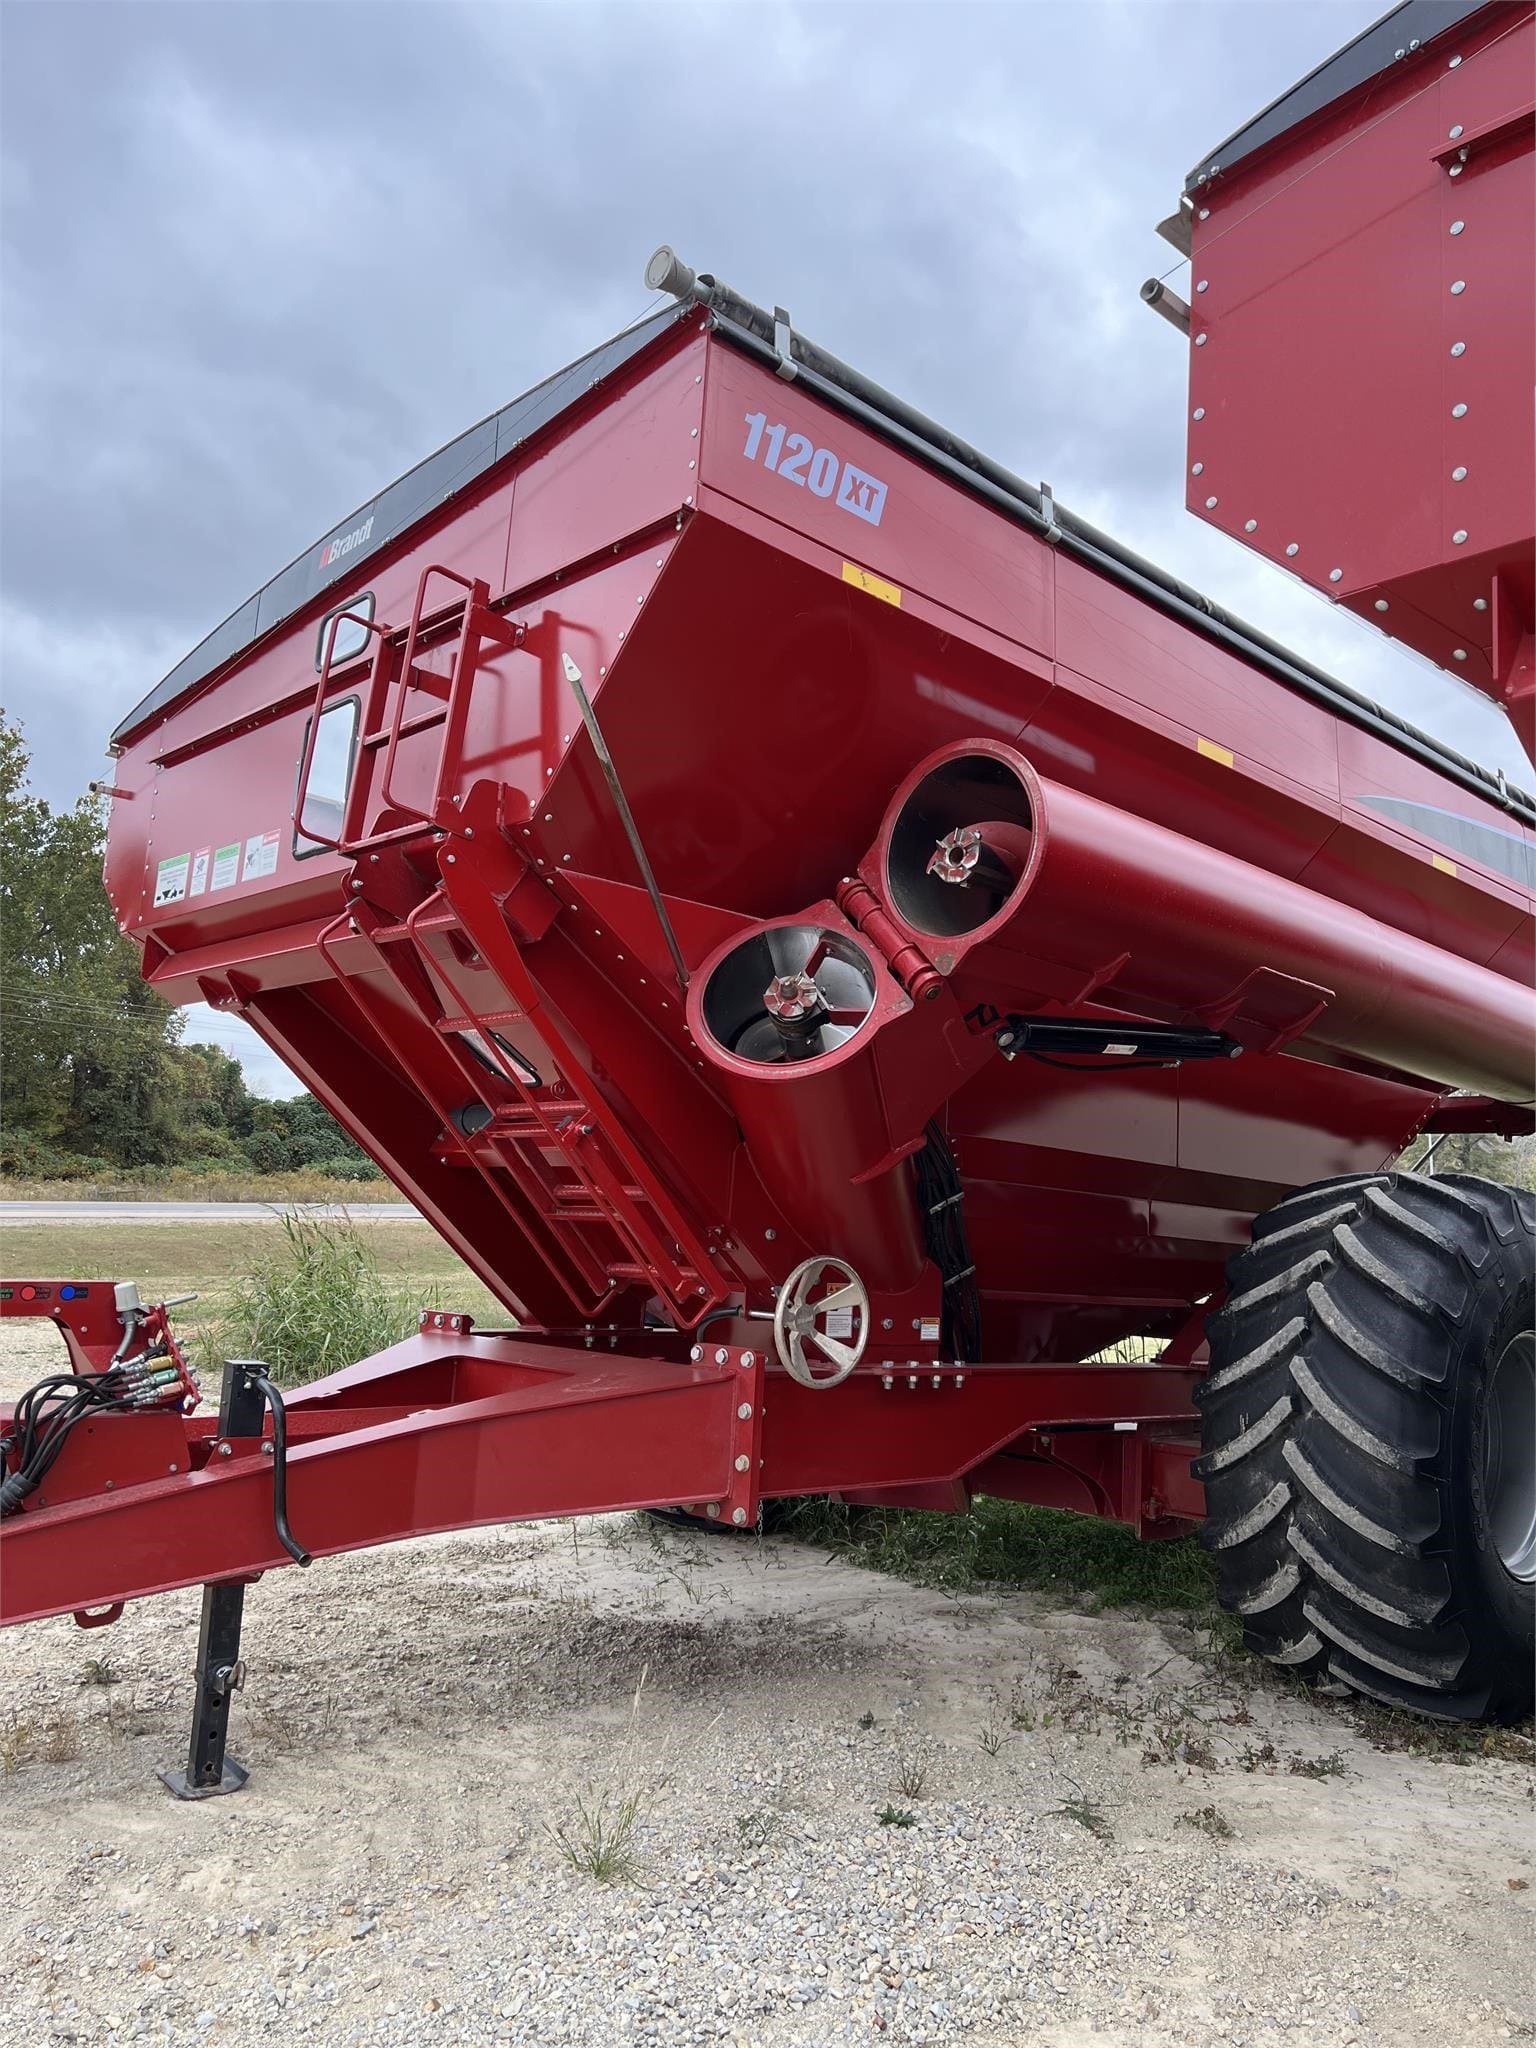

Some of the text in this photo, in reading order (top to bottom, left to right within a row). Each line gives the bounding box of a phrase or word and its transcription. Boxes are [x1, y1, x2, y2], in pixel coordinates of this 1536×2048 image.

[743, 411, 881, 514] 1120 XT
[326, 515, 375, 565] Brandt
